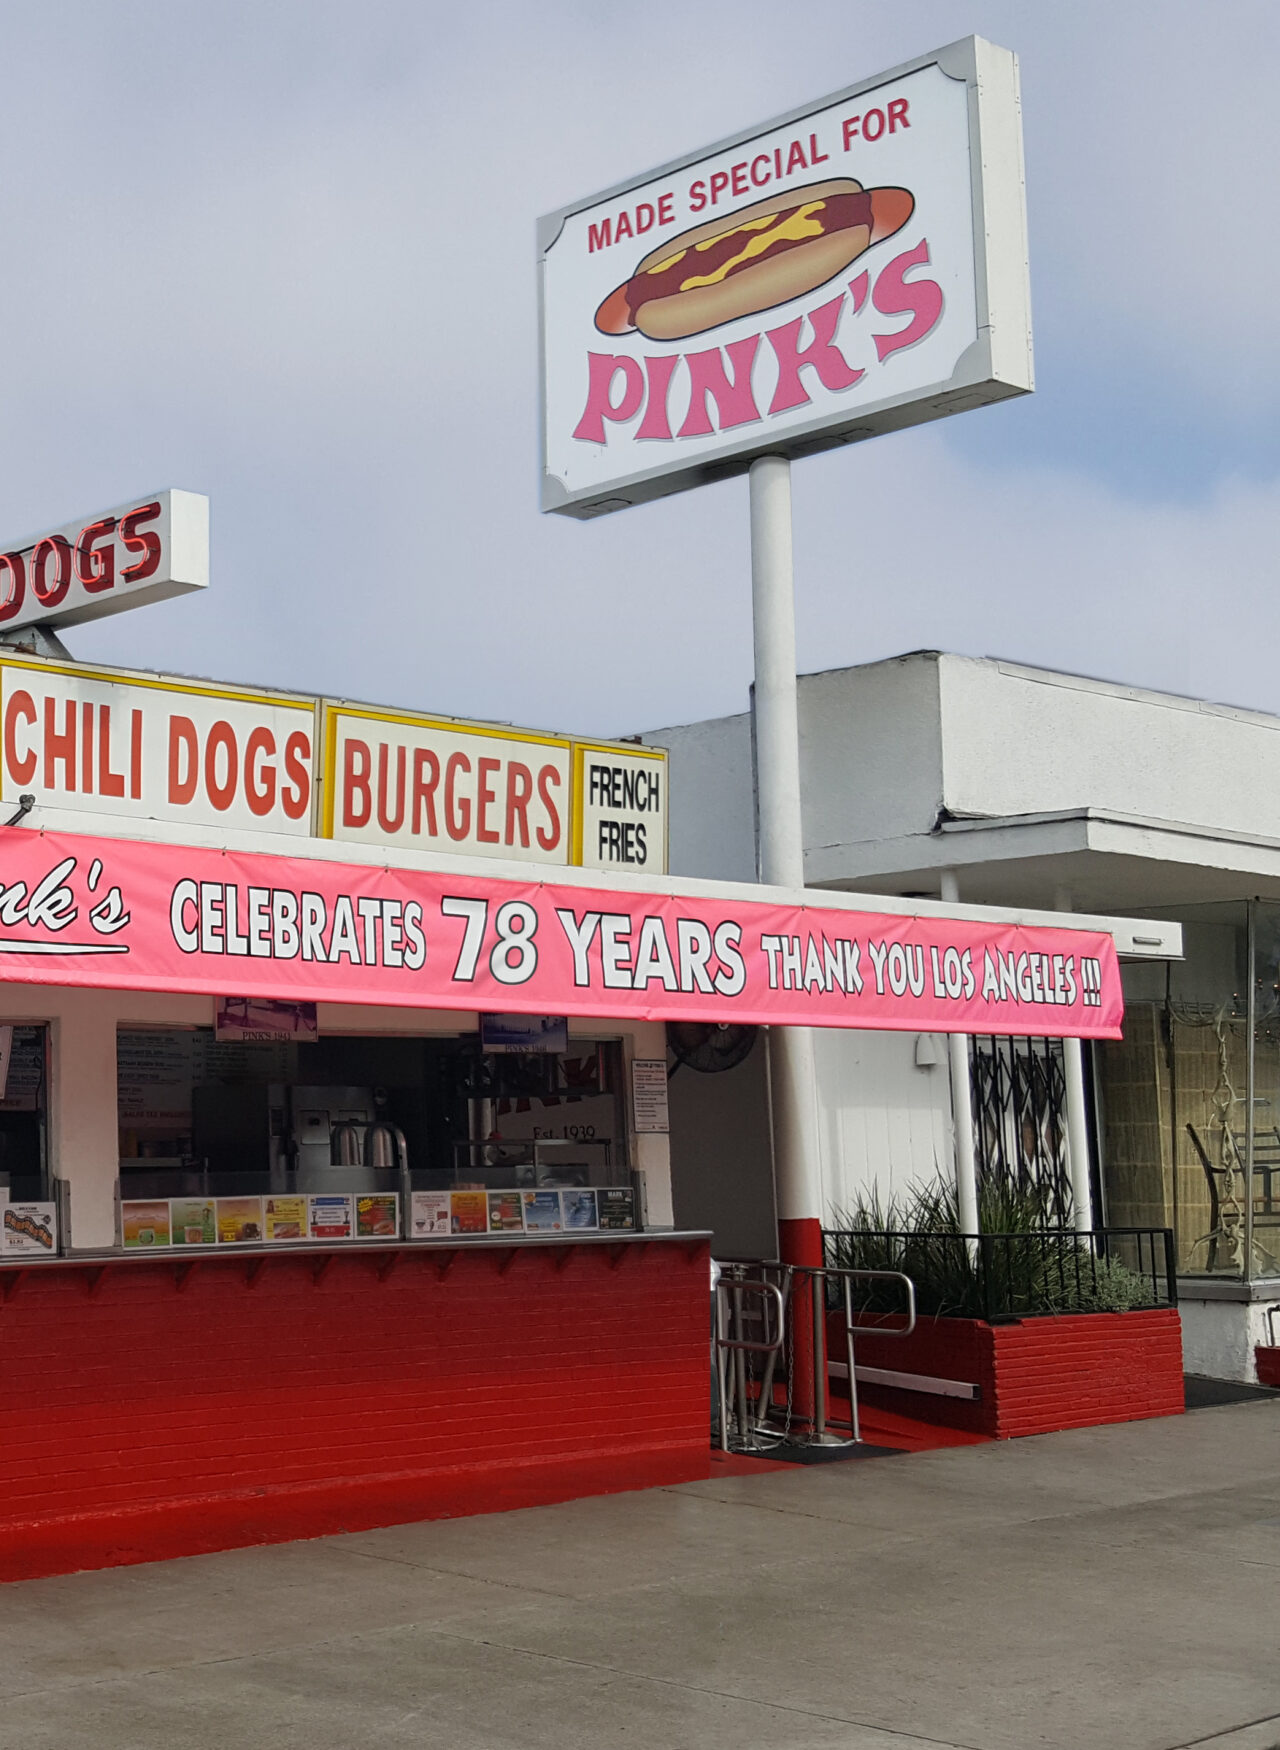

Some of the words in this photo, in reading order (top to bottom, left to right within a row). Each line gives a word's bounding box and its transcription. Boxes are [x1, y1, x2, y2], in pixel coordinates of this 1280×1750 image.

[587, 193, 677, 254] MADE
[689, 133, 829, 212] SPECIAL
[841, 97, 911, 153] FOR
[571, 237, 945, 444] PINK'S
[4, 689, 143, 801] CHILI
[168, 715, 311, 820] DOGS
[342, 738, 561, 852] BURGERS
[590, 763, 660, 814] FRENCH
[598, 819, 648, 866] FRIES
[171, 878, 426, 971] CELEBRATES
[441, 896, 539, 985] 78
[555, 908, 747, 997] YEARS
[761, 931, 864, 998] THANK
[869, 939, 924, 997] YOU
[931, 945, 975, 1000] LOS
[982, 944, 1077, 1006] ANGELES
